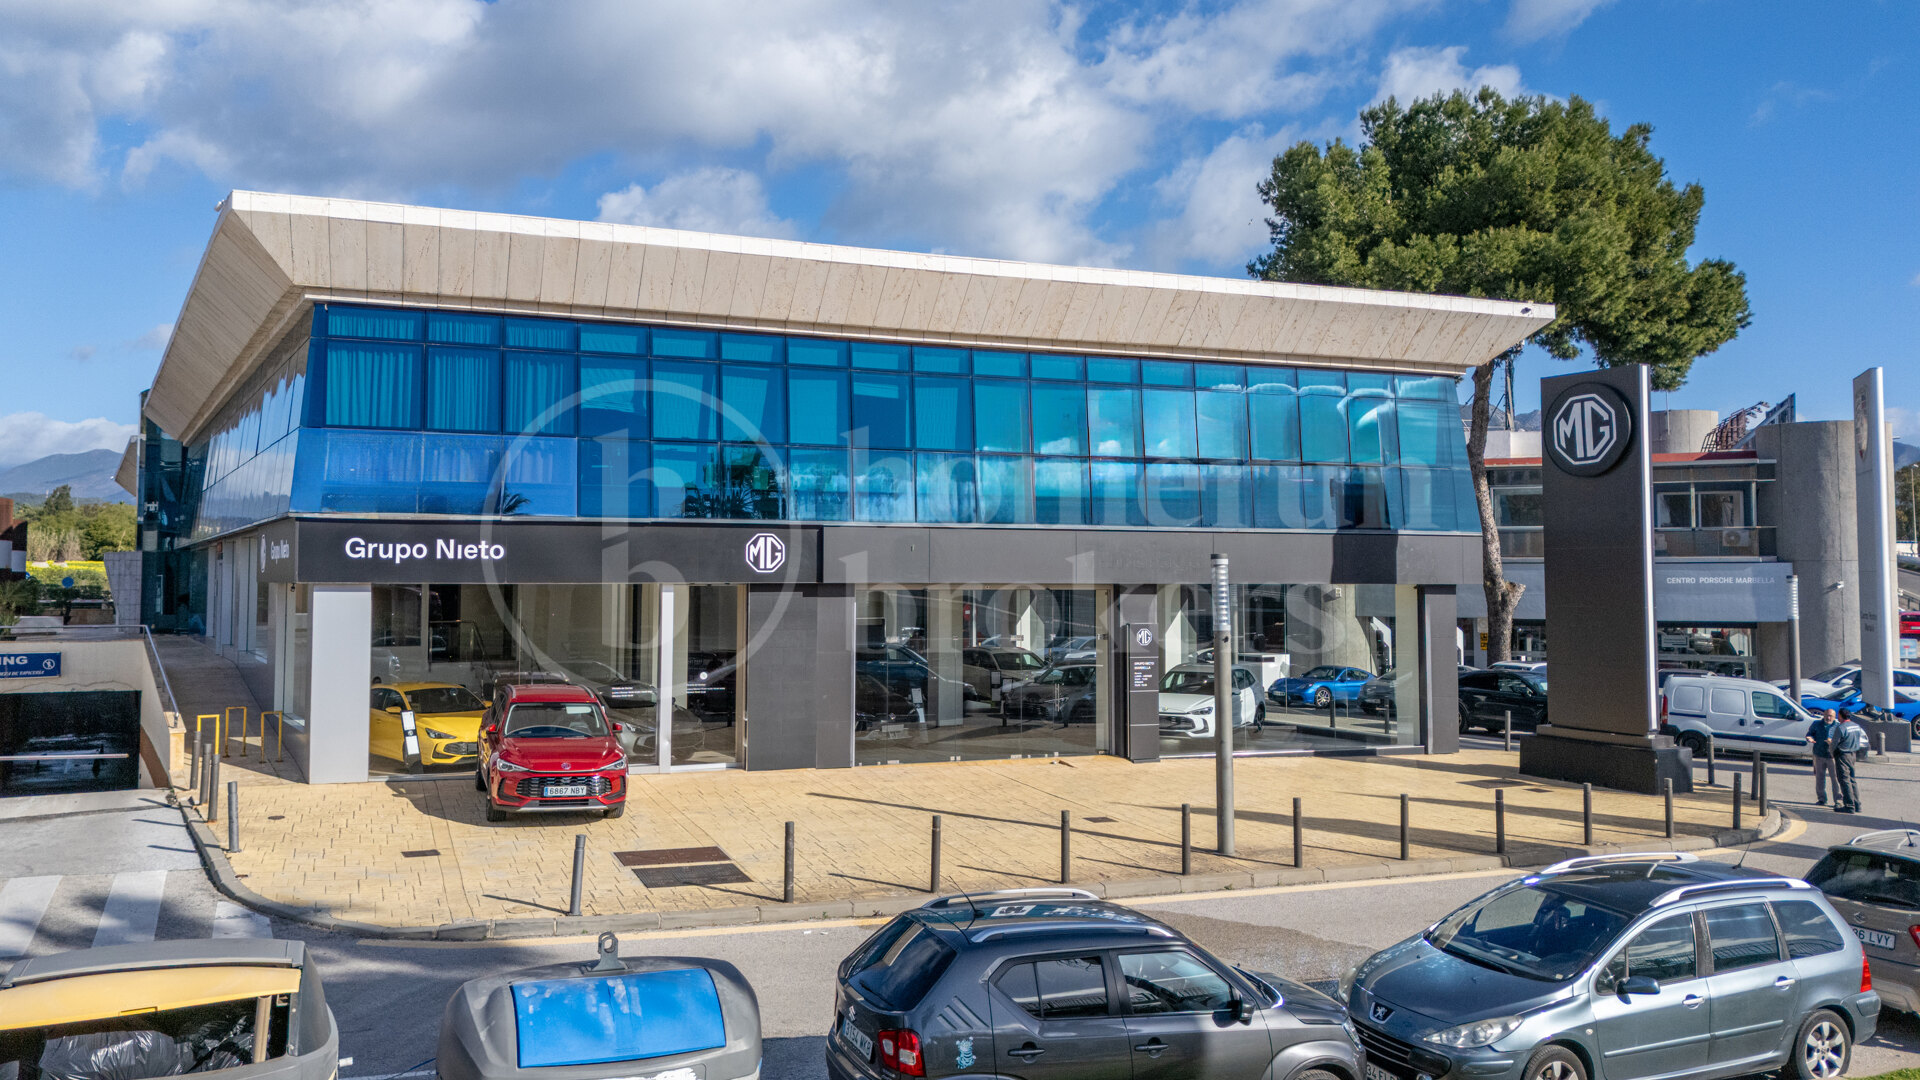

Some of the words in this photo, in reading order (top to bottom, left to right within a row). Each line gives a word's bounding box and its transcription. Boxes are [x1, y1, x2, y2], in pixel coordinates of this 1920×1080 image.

[1558, 400, 1611, 459] MG
[345, 537, 428, 564] Grupo
[749, 536, 782, 569] MG
[1699, 576, 1734, 584] PORSCHE
[1138, 630, 1151, 644] MG
[549, 787, 569, 795] 6867
[570, 786, 585, 794] NBY
[1869, 931, 1890, 946] LVY
